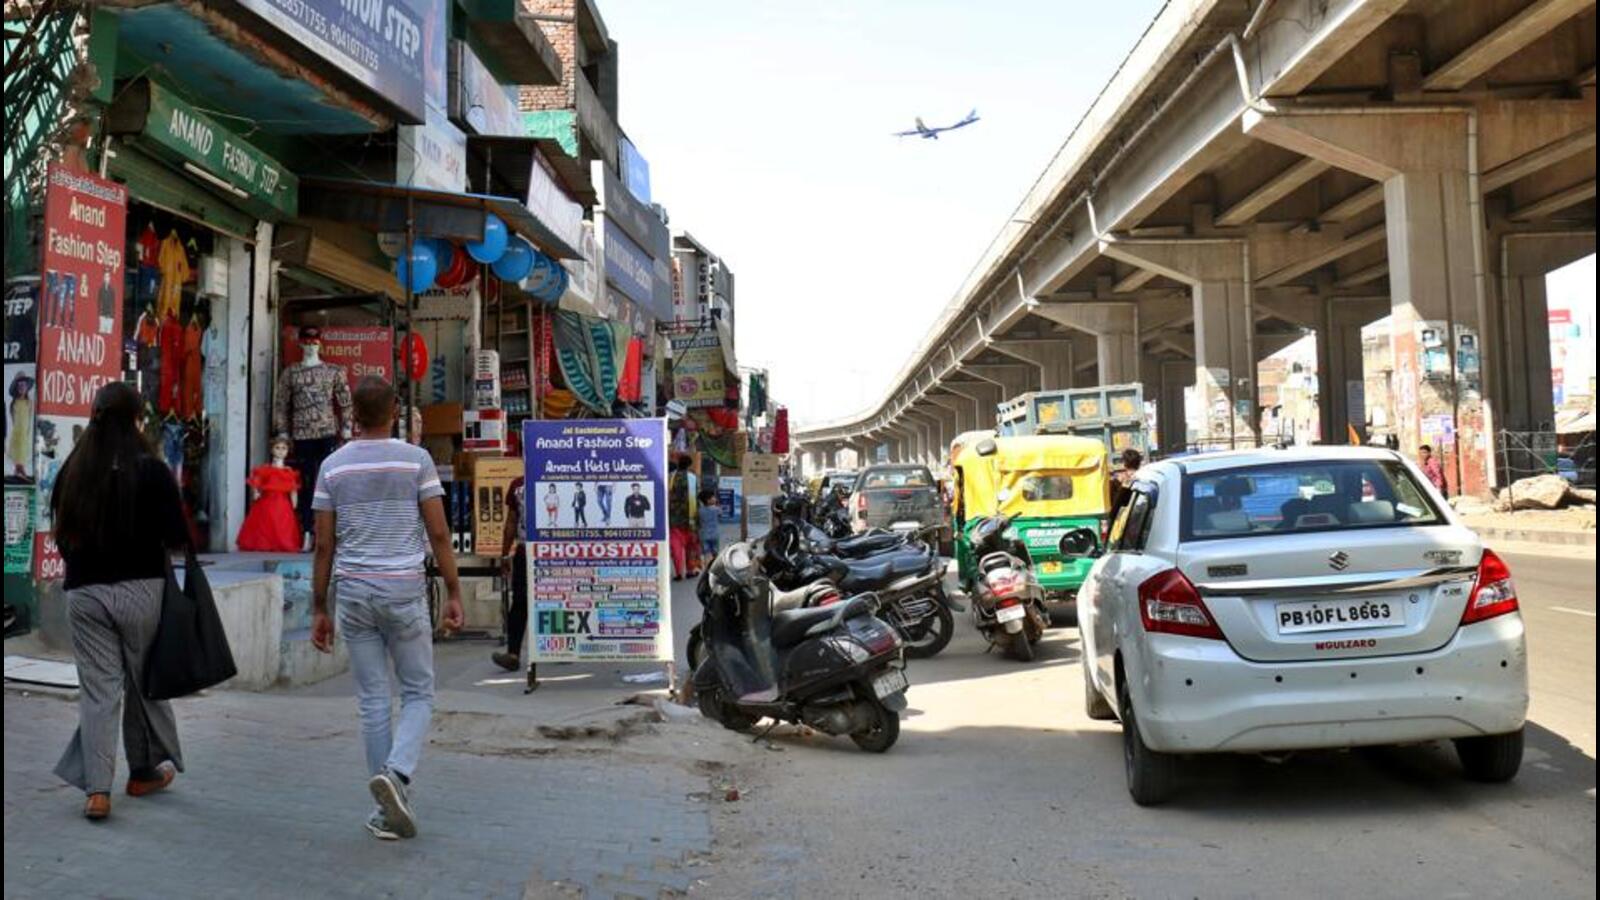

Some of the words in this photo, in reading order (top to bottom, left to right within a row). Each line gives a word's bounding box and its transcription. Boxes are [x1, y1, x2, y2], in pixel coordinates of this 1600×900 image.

[384, 5, 420, 59] STEP
[169, 108, 213, 157] ANAND
[69, 196, 106, 228] Anand
[49, 228, 94, 262] Fashion
[97, 241, 121, 272] Step
[80, 274, 88, 298] &
[57, 330, 105, 367] ANAND
[43, 368, 75, 405] KIDS
[702, 380, 722, 392] LG
[536, 437, 573, 449] Anand
[576, 436, 622, 448] Fashion
[625, 436, 654, 448] Step
[545, 460, 582, 473] Anand
[584, 459, 610, 472] Kids
[612, 458, 645, 472] Wear
[537, 543, 656, 558] PHOTOSTAT
[538, 610, 591, 634] FLEX
[1280, 603, 1391, 627] PB10FL8663
